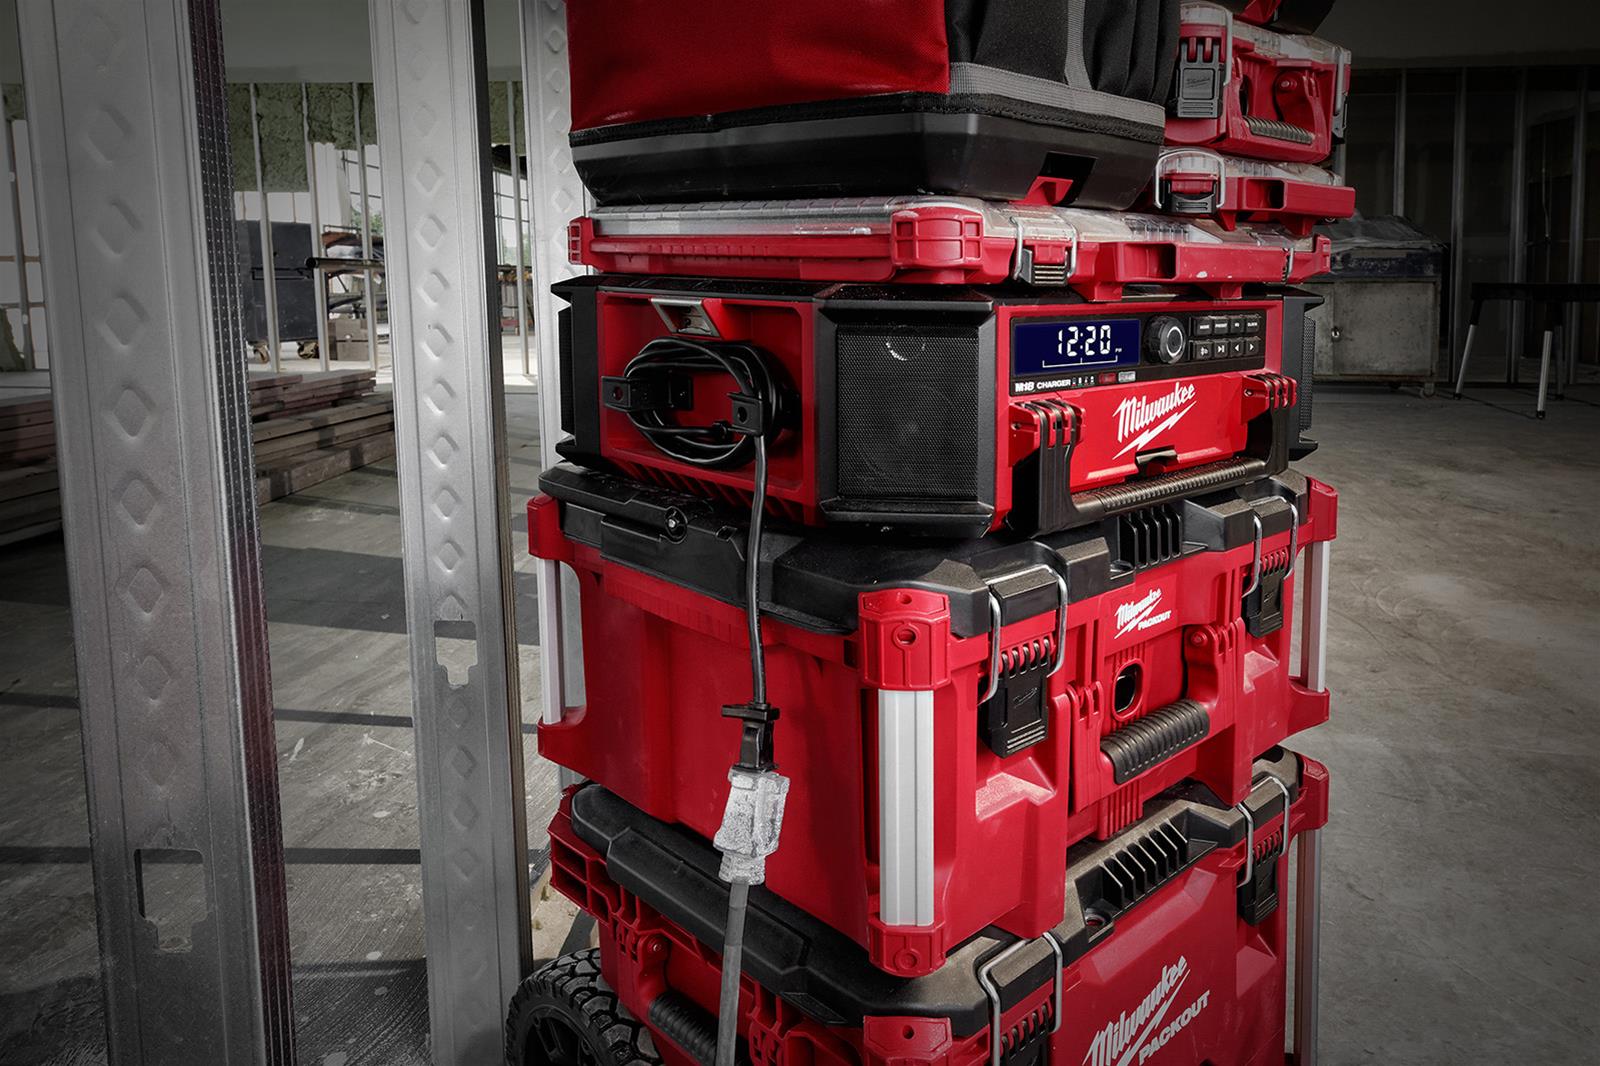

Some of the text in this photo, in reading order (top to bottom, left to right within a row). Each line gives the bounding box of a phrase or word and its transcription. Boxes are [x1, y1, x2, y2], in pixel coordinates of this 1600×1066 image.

[1057, 324, 1111, 357] 12:20
[1036, 379, 1072, 390] CHARGER
[1112, 381, 1196, 444] Milwaukee
[1114, 588, 1163, 631] Milwaukee
[1081, 955, 1188, 1066] Milwaukee
[1138, 989, 1210, 1066] PACKOUT
